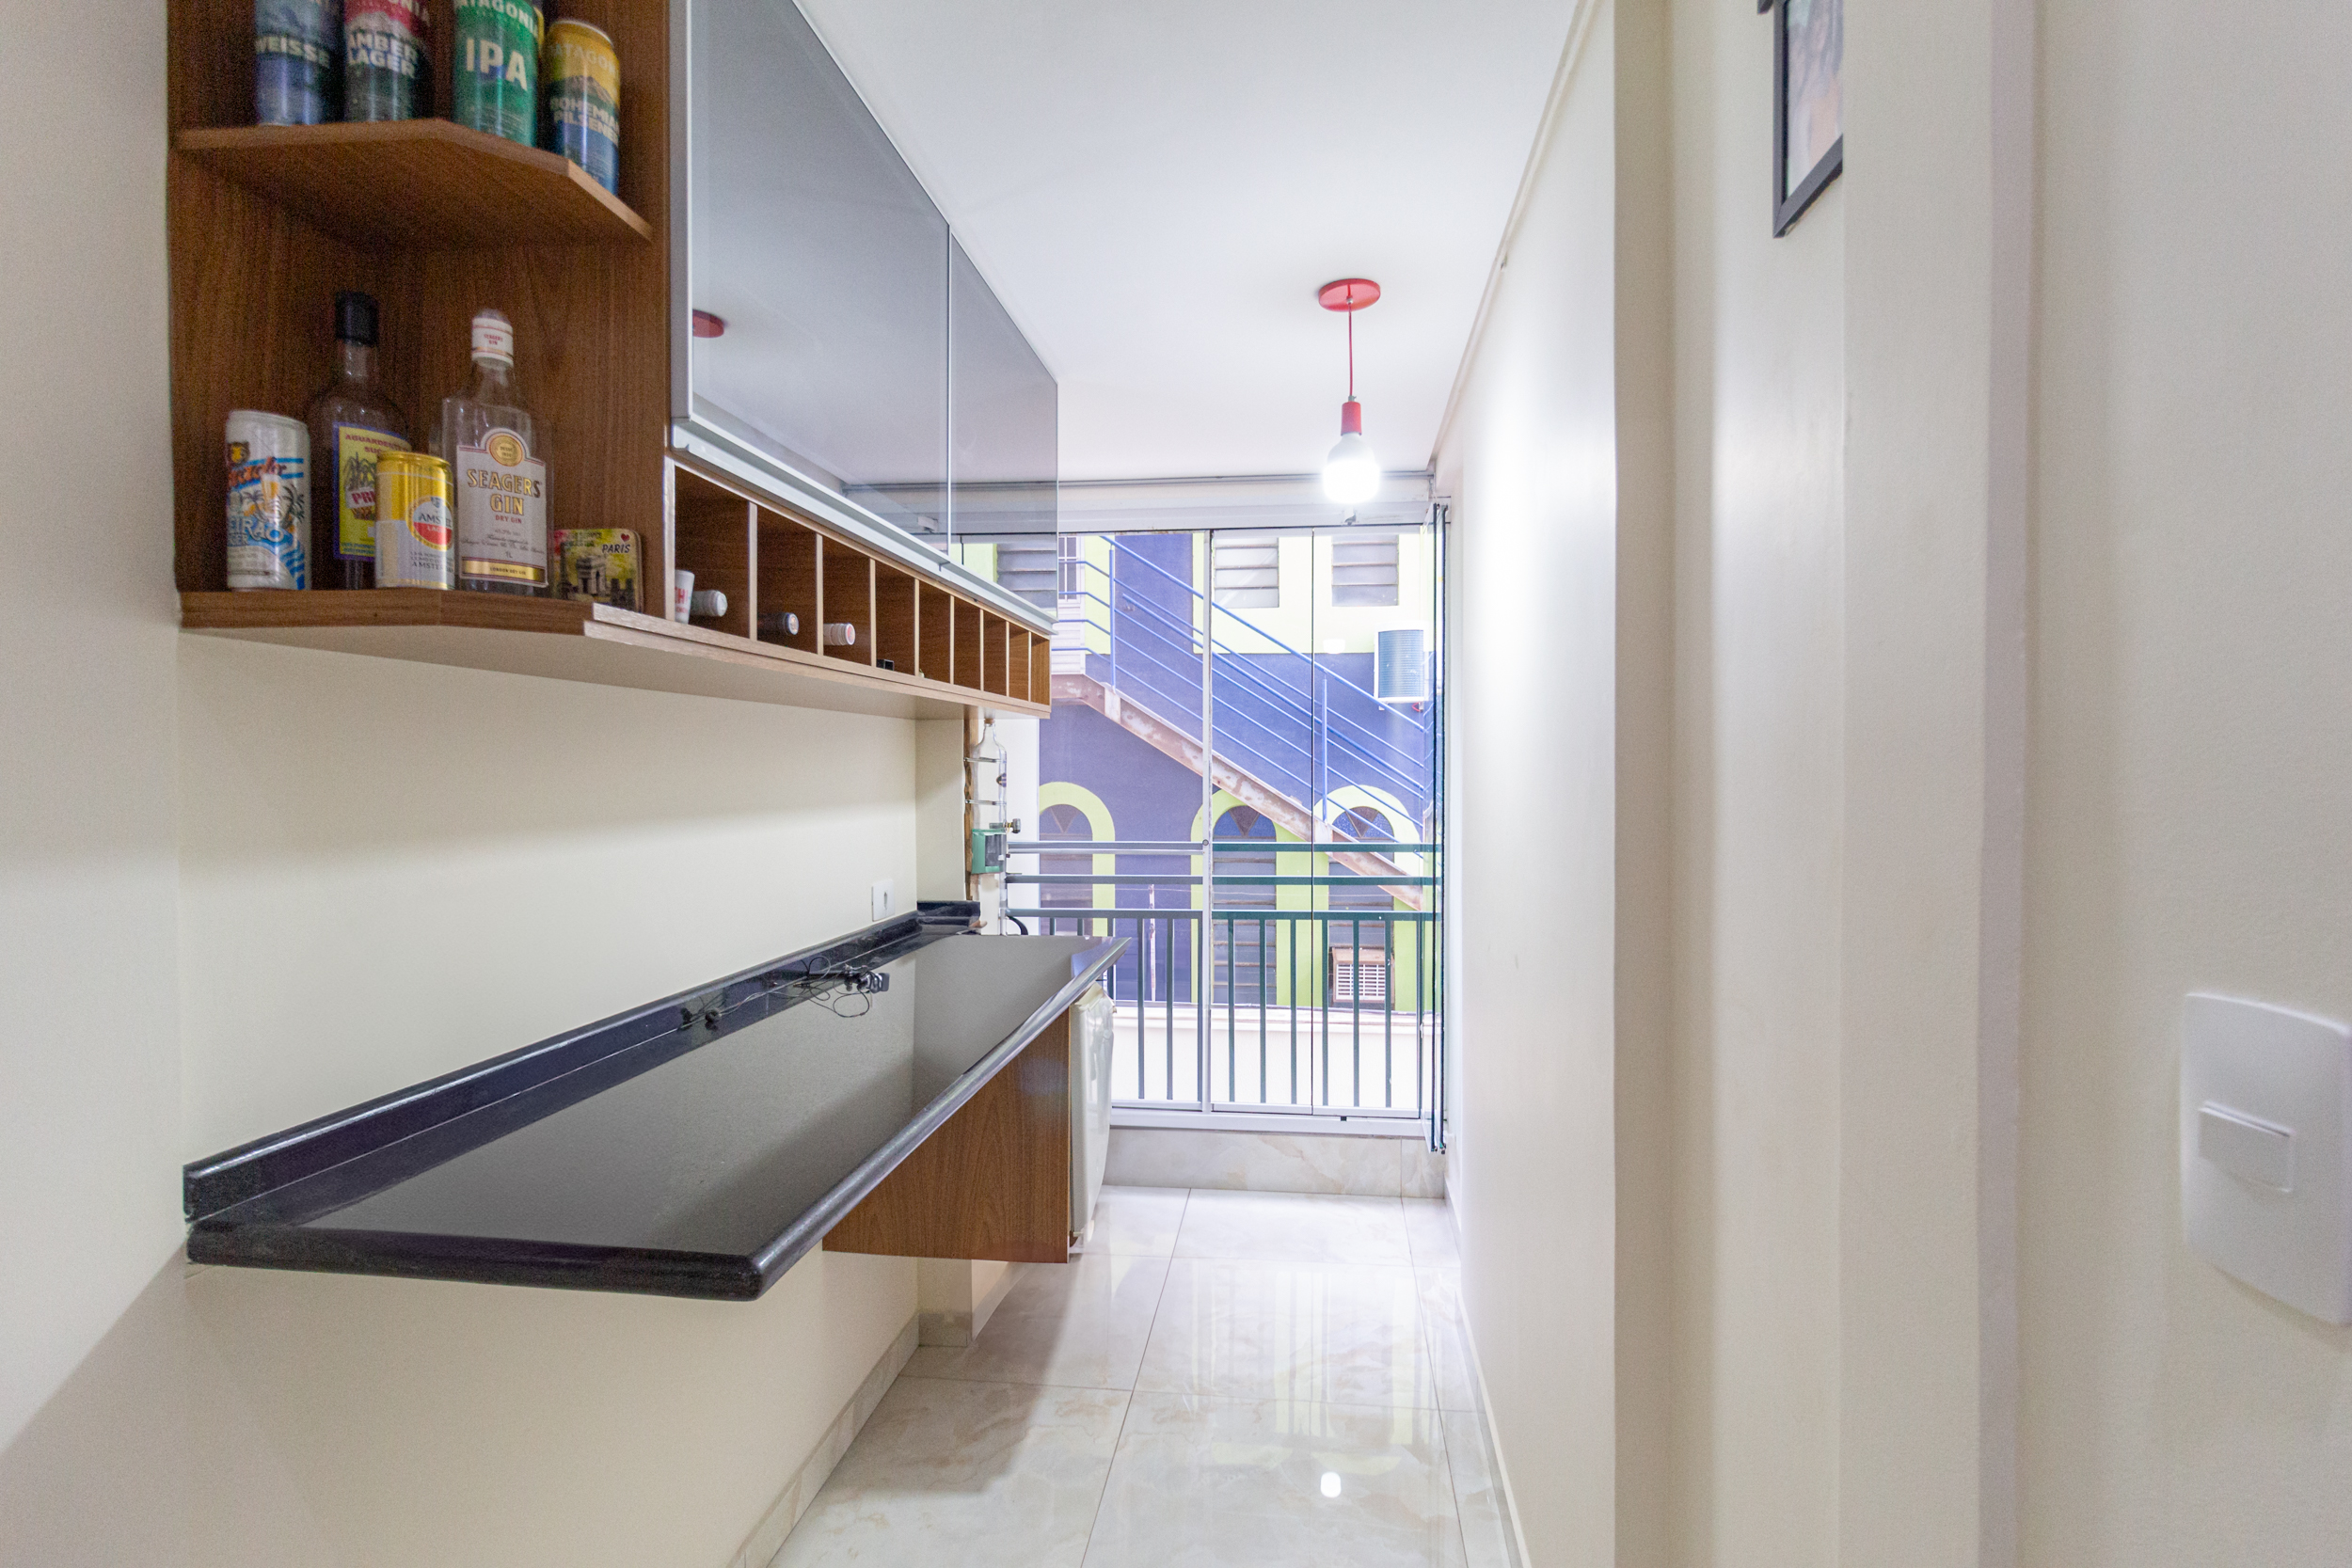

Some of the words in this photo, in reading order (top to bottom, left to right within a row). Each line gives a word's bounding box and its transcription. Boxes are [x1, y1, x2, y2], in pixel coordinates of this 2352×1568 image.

[255, 36, 329, 69] WEISSE
[347, 33, 418, 65] AMBER
[348, 48, 415, 79] LAGER
[466, 39, 528, 91] IPA
[467, 468, 541, 499] SEAGERS
[490, 494, 524, 516] GIN
[602, 544, 630, 553] PARIS
